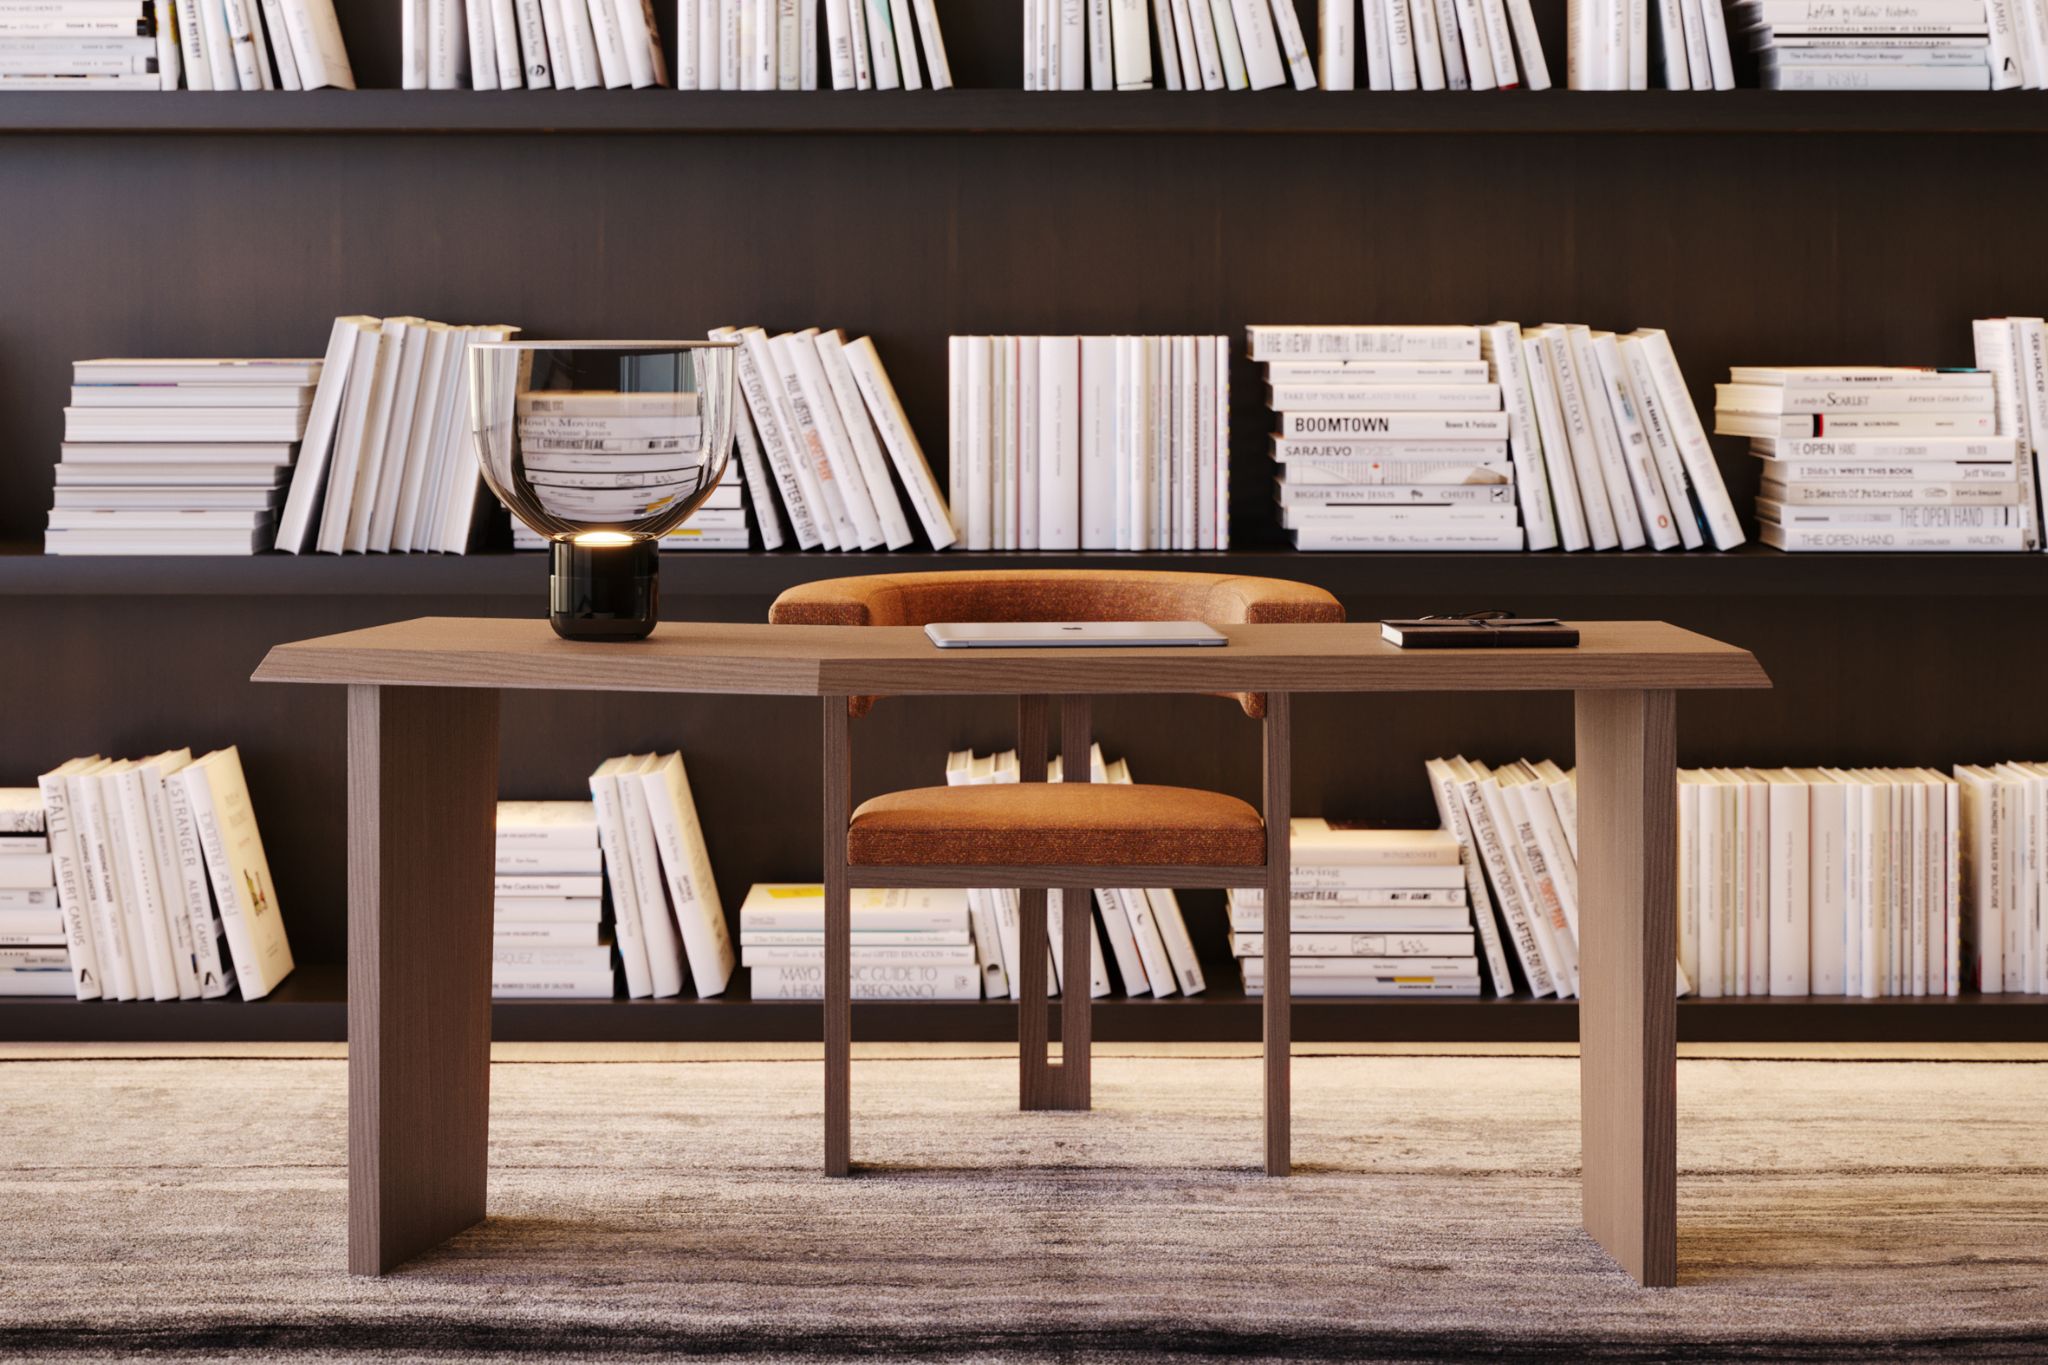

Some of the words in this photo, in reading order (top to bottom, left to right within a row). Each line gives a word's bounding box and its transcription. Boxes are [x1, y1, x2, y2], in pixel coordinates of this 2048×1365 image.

[1295, 417, 1388, 432] BOOMTOWN
[1284, 446, 1351, 456] SARAJEVO
[1802, 443, 1835, 455] OPEN
[780, 472, 800, 505] AFTER
[1294, 490, 1331, 499] BIGGER
[1336, 490, 1363, 499] THAN
[1367, 490, 1394, 498] JESUS
[1921, 507, 1950, 527] OPEN
[1954, 507, 1983, 527] HAND
[1800, 534, 1823, 545] THE
[1825, 534, 1859, 545] OPEN
[1861, 534, 1894, 545] HAND
[1461, 780, 1482, 805] FIND
[1471, 804, 1489, 825] THE
[170, 788, 196, 867] STRANGER
[1478, 824, 1500, 853] LOVE
[46, 793, 69, 838] FALL
[58, 854, 76, 901] ALBERT
[67, 904, 85, 946] CAMUS
[1489, 852, 1506, 869] OF
[1495, 868, 1518, 899] YOUR
[186, 878, 203, 919] ALBERT
[1506, 896, 1525, 920] LIFE
[194, 922, 210, 959] CAMUS
[1514, 918, 1538, 953] AFTER
[779, 967, 821, 980] MAYO
[871, 967, 916, 980] GUIDE
[919, 967, 937, 980] TO
[856, 984, 937, 998] PREGNANCY
